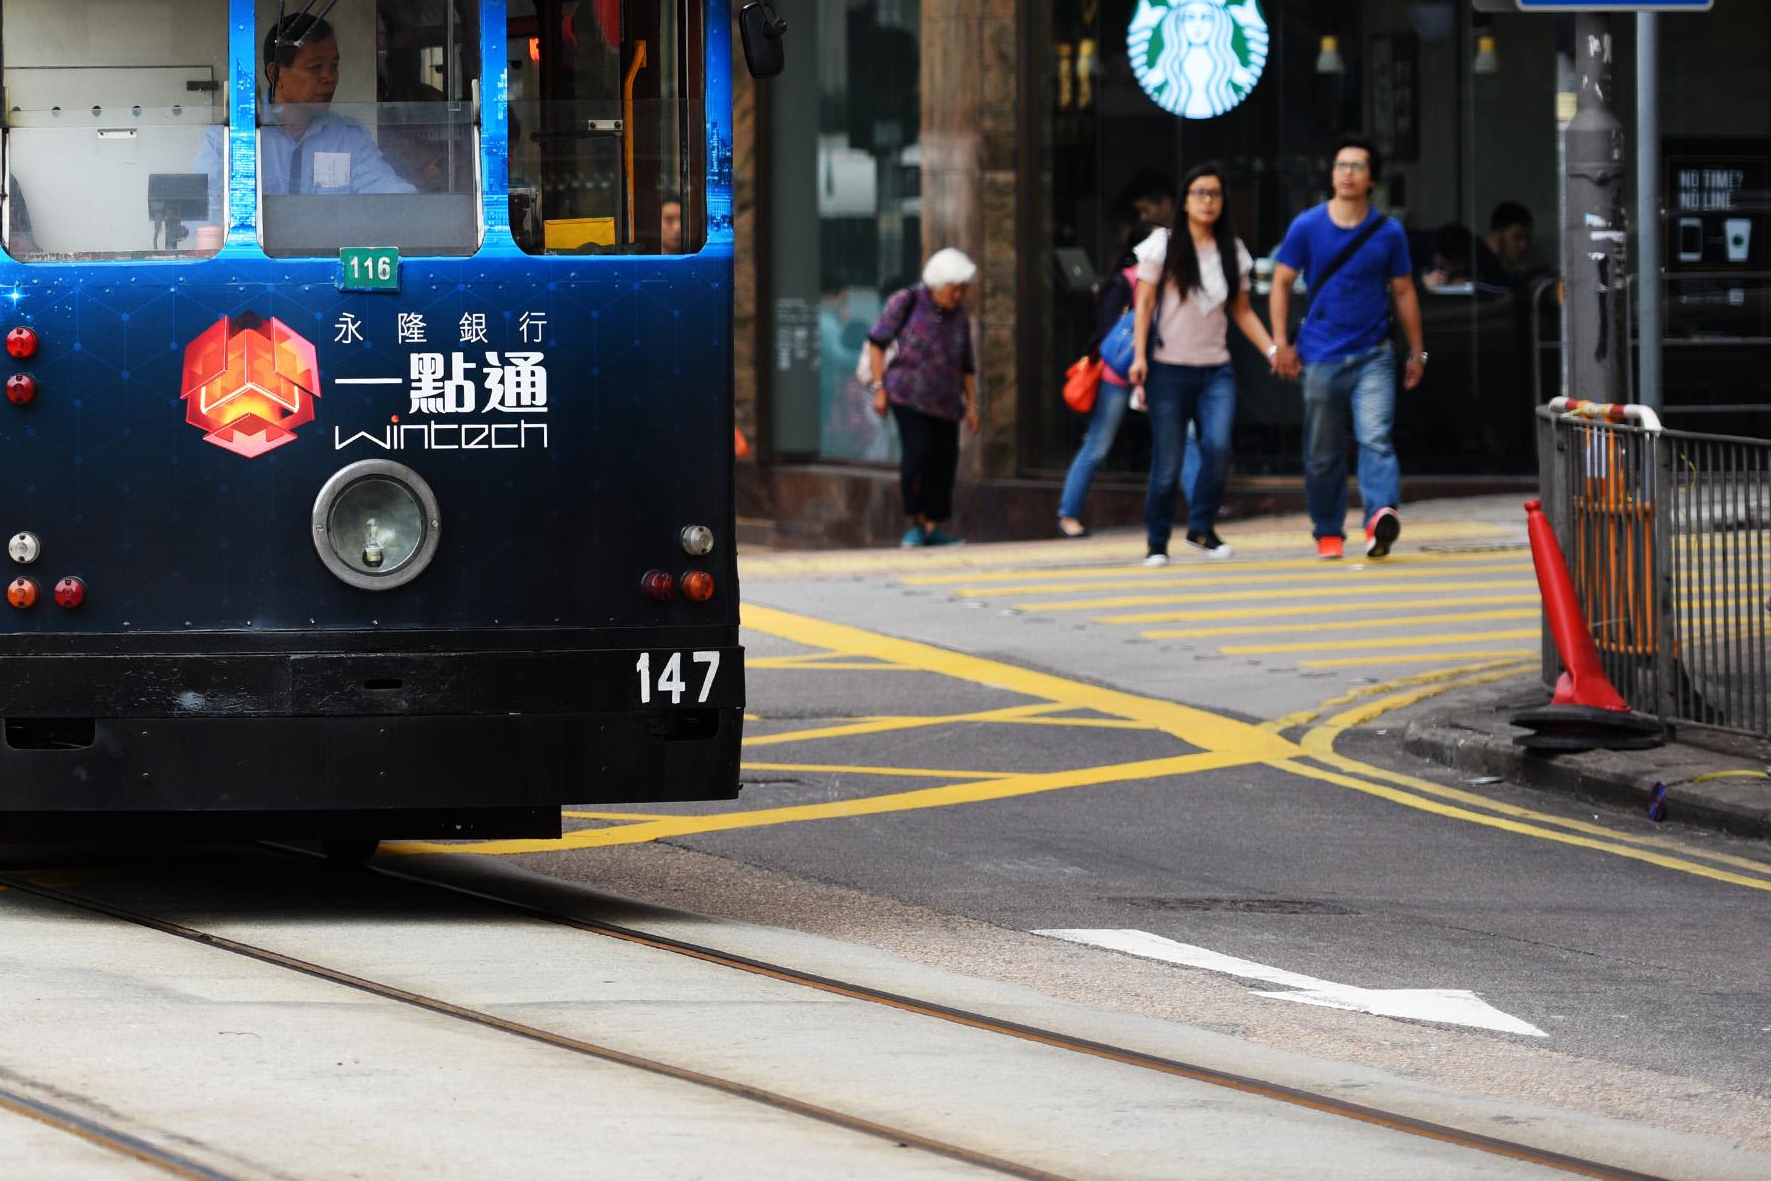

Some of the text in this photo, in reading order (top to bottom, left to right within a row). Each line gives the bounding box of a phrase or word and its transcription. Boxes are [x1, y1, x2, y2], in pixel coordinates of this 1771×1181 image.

[1679, 169, 1699, 187] NO
[1679, 193, 1699, 211] NO
[350, 256, 391, 280] 116
[334, 311, 547, 344] 永隆銀行
[334, 351, 548, 414] 一點通
[335, 414, 548, 450] wintech
[635, 650, 720, 704] 147
